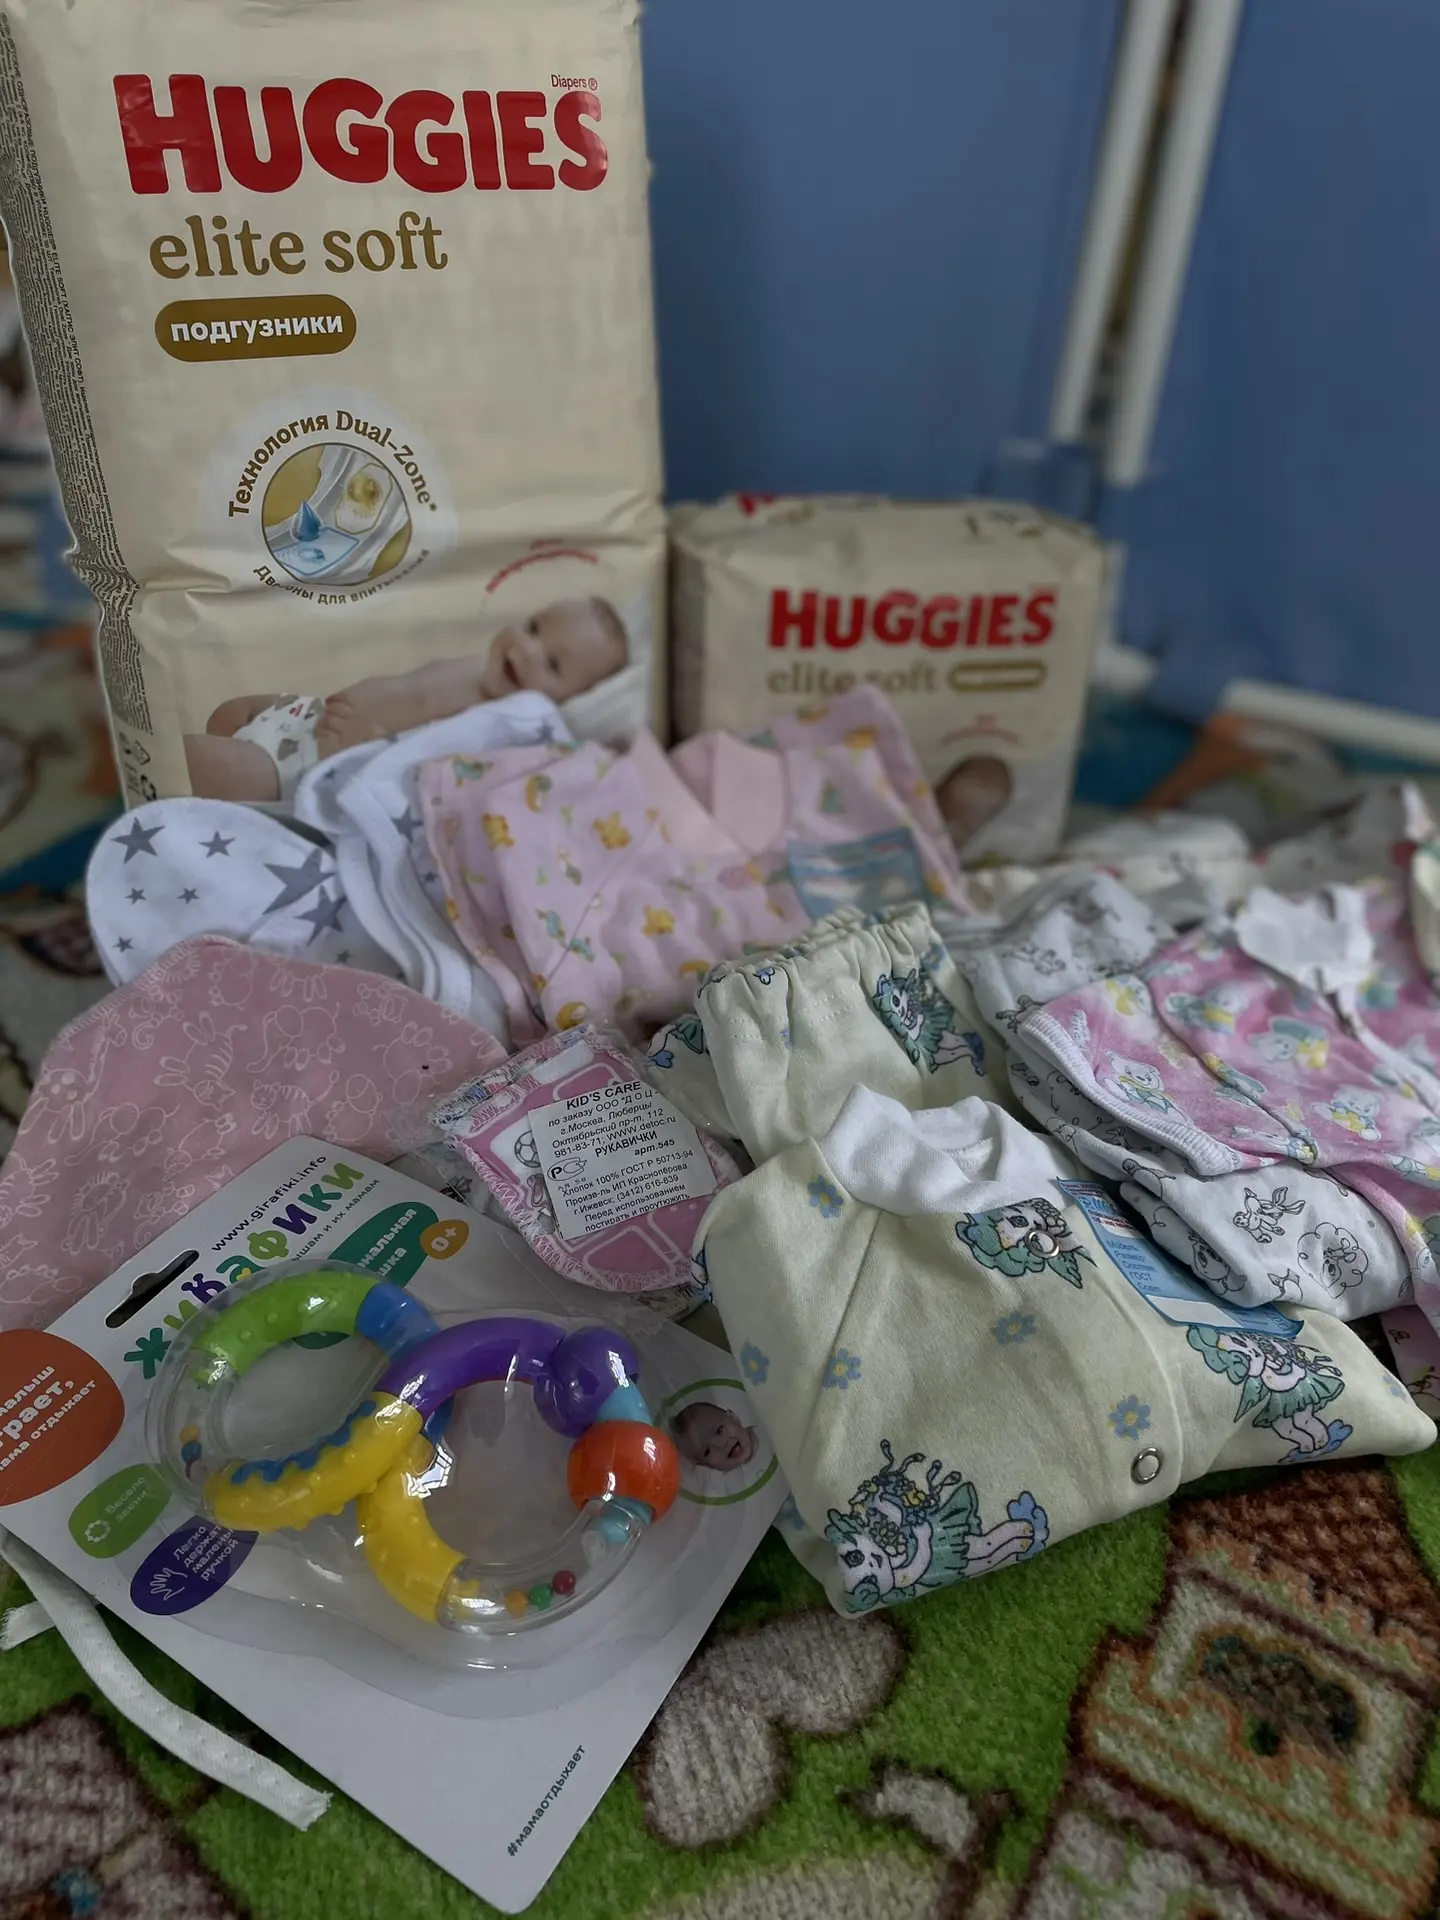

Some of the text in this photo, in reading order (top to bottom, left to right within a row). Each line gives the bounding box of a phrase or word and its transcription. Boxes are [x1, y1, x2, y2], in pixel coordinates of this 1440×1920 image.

[113, 73, 608, 194] HUGGIES
[150, 211, 448, 279] elite soft
[171, 314, 343, 345] подгузники
[229, 415, 329, 517] Технология
[318, 594, 347, 605] для
[767, 588, 1057, 651] HUGGIES
[548, 1119, 560, 1127] по
[563, 1108, 594, 1123] заказу
[596, 1099, 619, 1112] ООО
[566, 1081, 641, 1110] KID'S CARE
[608, 1103, 652, 1120] Люберцы
[552, 1122, 617, 1149] Октябрьский
[648, 1108, 664, 1119] 112
[595, 1130, 658, 1157] РУКАВИЧКИ
[634, 1139, 675, 1156] арт.545
[562, 1150, 694, 1197] Хлопок 100% ГОСТ Р 50713-94
[616, 1185, 644, 1202] (3412)
[645, 1174, 679, 1191] 616-839
[211, 1155, 327, 1252] www.girafiki.info
[323, 1224, 333, 1233] и
[333, 1211, 346, 1224] их
[346, 1179, 380, 1211] мамам
[565, 1188, 611, 1208] Произв-ль
[612, 1181, 626, 1191] ИП
[584, 1184, 686, 1223] Перед использованием
[431, 1227, 457, 1252] 0+
[585, 1214, 629, 1232] постирать
[30, 1380, 96, 1440] отдыхает
[173, 1526, 207, 1561] Легко
[201, 1538, 239, 1582] ручкой
[507, 1745, 585, 1856] #мамаотдыхает
